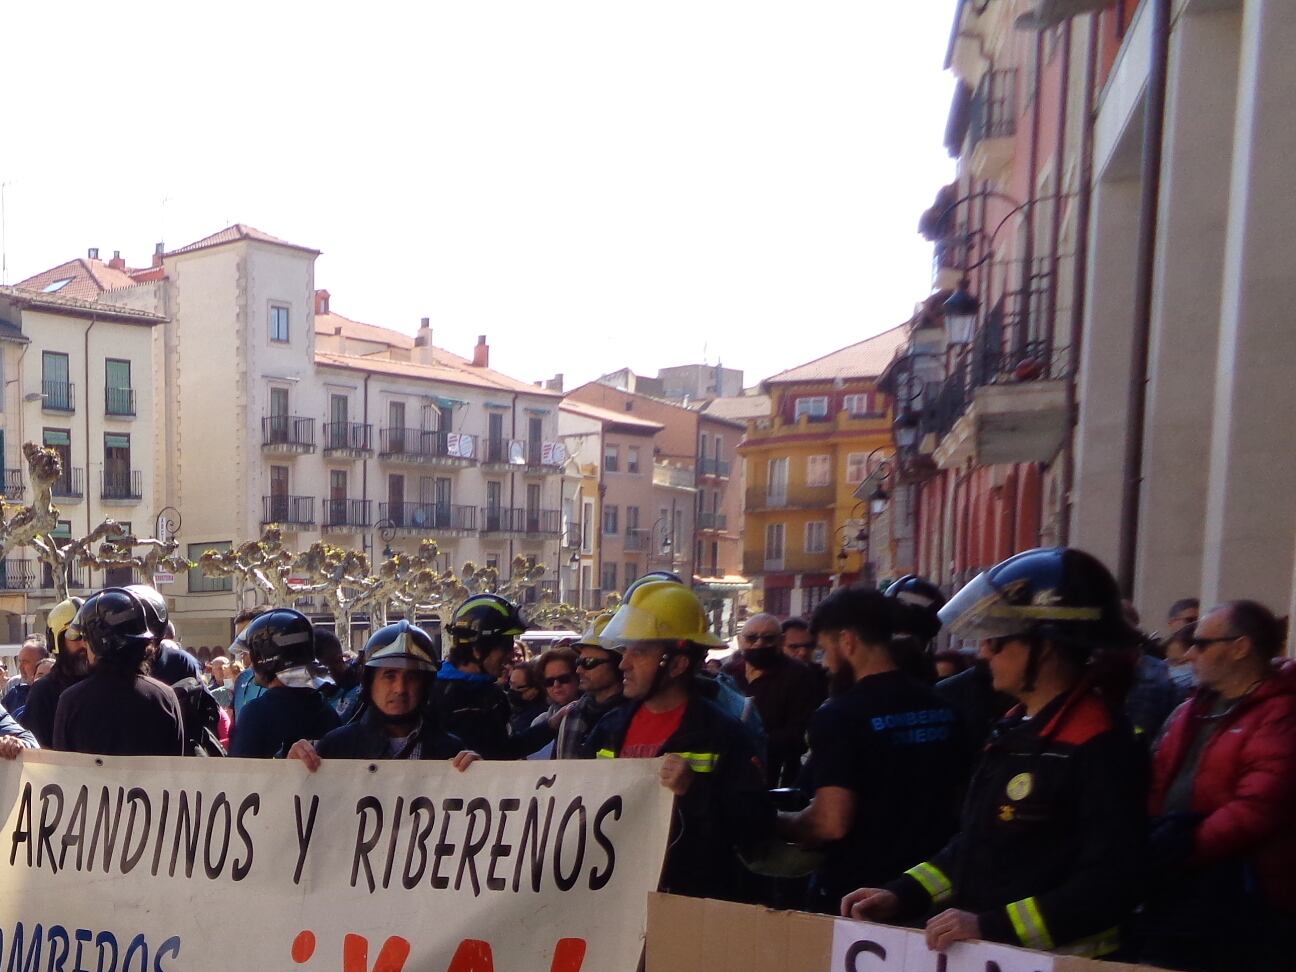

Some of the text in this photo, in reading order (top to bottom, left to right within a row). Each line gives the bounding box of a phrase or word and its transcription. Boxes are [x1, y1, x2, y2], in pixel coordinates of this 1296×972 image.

[9, 782, 261, 882] ARANDINOS
[293, 794, 320, 886] Y
[350, 774, 623, 895] RIBEREÑOS
